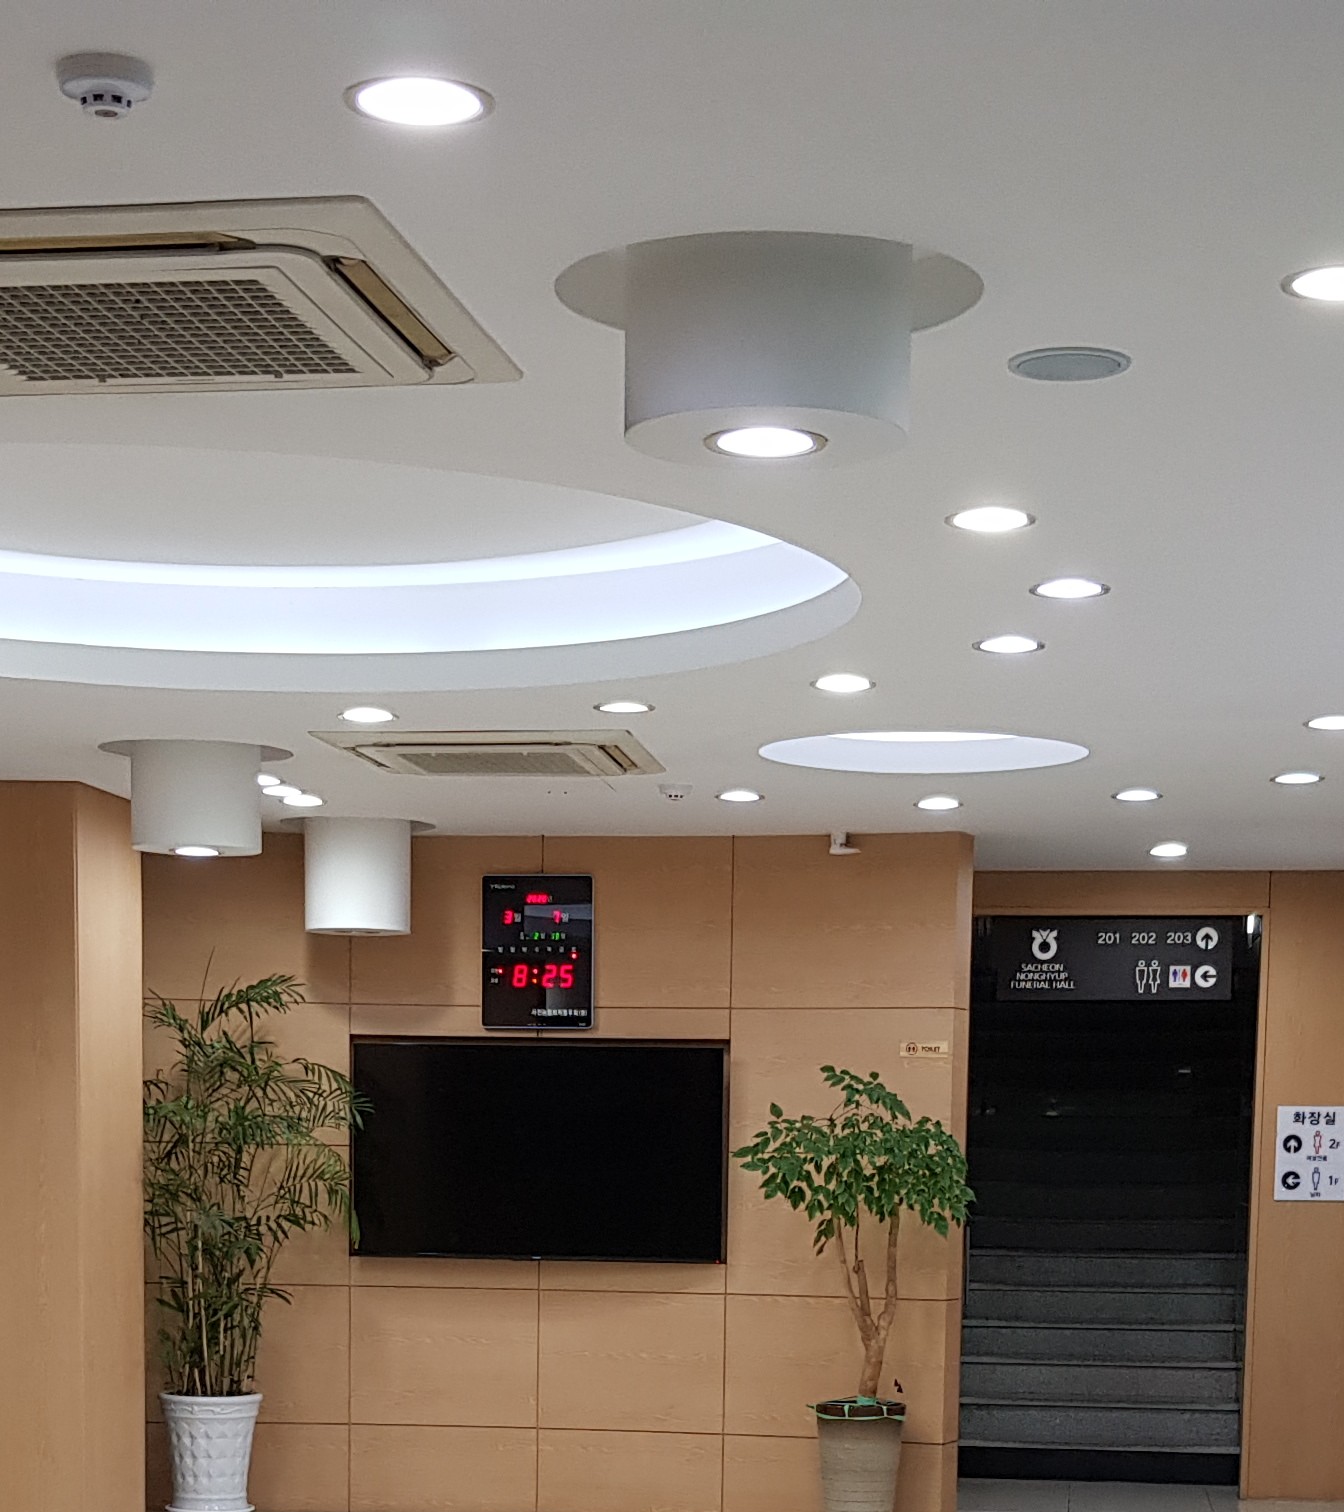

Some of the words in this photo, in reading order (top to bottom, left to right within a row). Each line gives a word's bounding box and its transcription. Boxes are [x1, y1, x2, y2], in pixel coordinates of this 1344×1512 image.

[1097, 932, 1120, 945] 201
[1131, 932, 1156, 945] 202
[1167, 932, 1192, 945] 203
[512, 964, 574, 989] 8:25
[1052, 981, 1076, 990] HALL
[1293, 1111, 1336, 1126] 화장실
[1328, 1139, 1341, 1150] 2F
